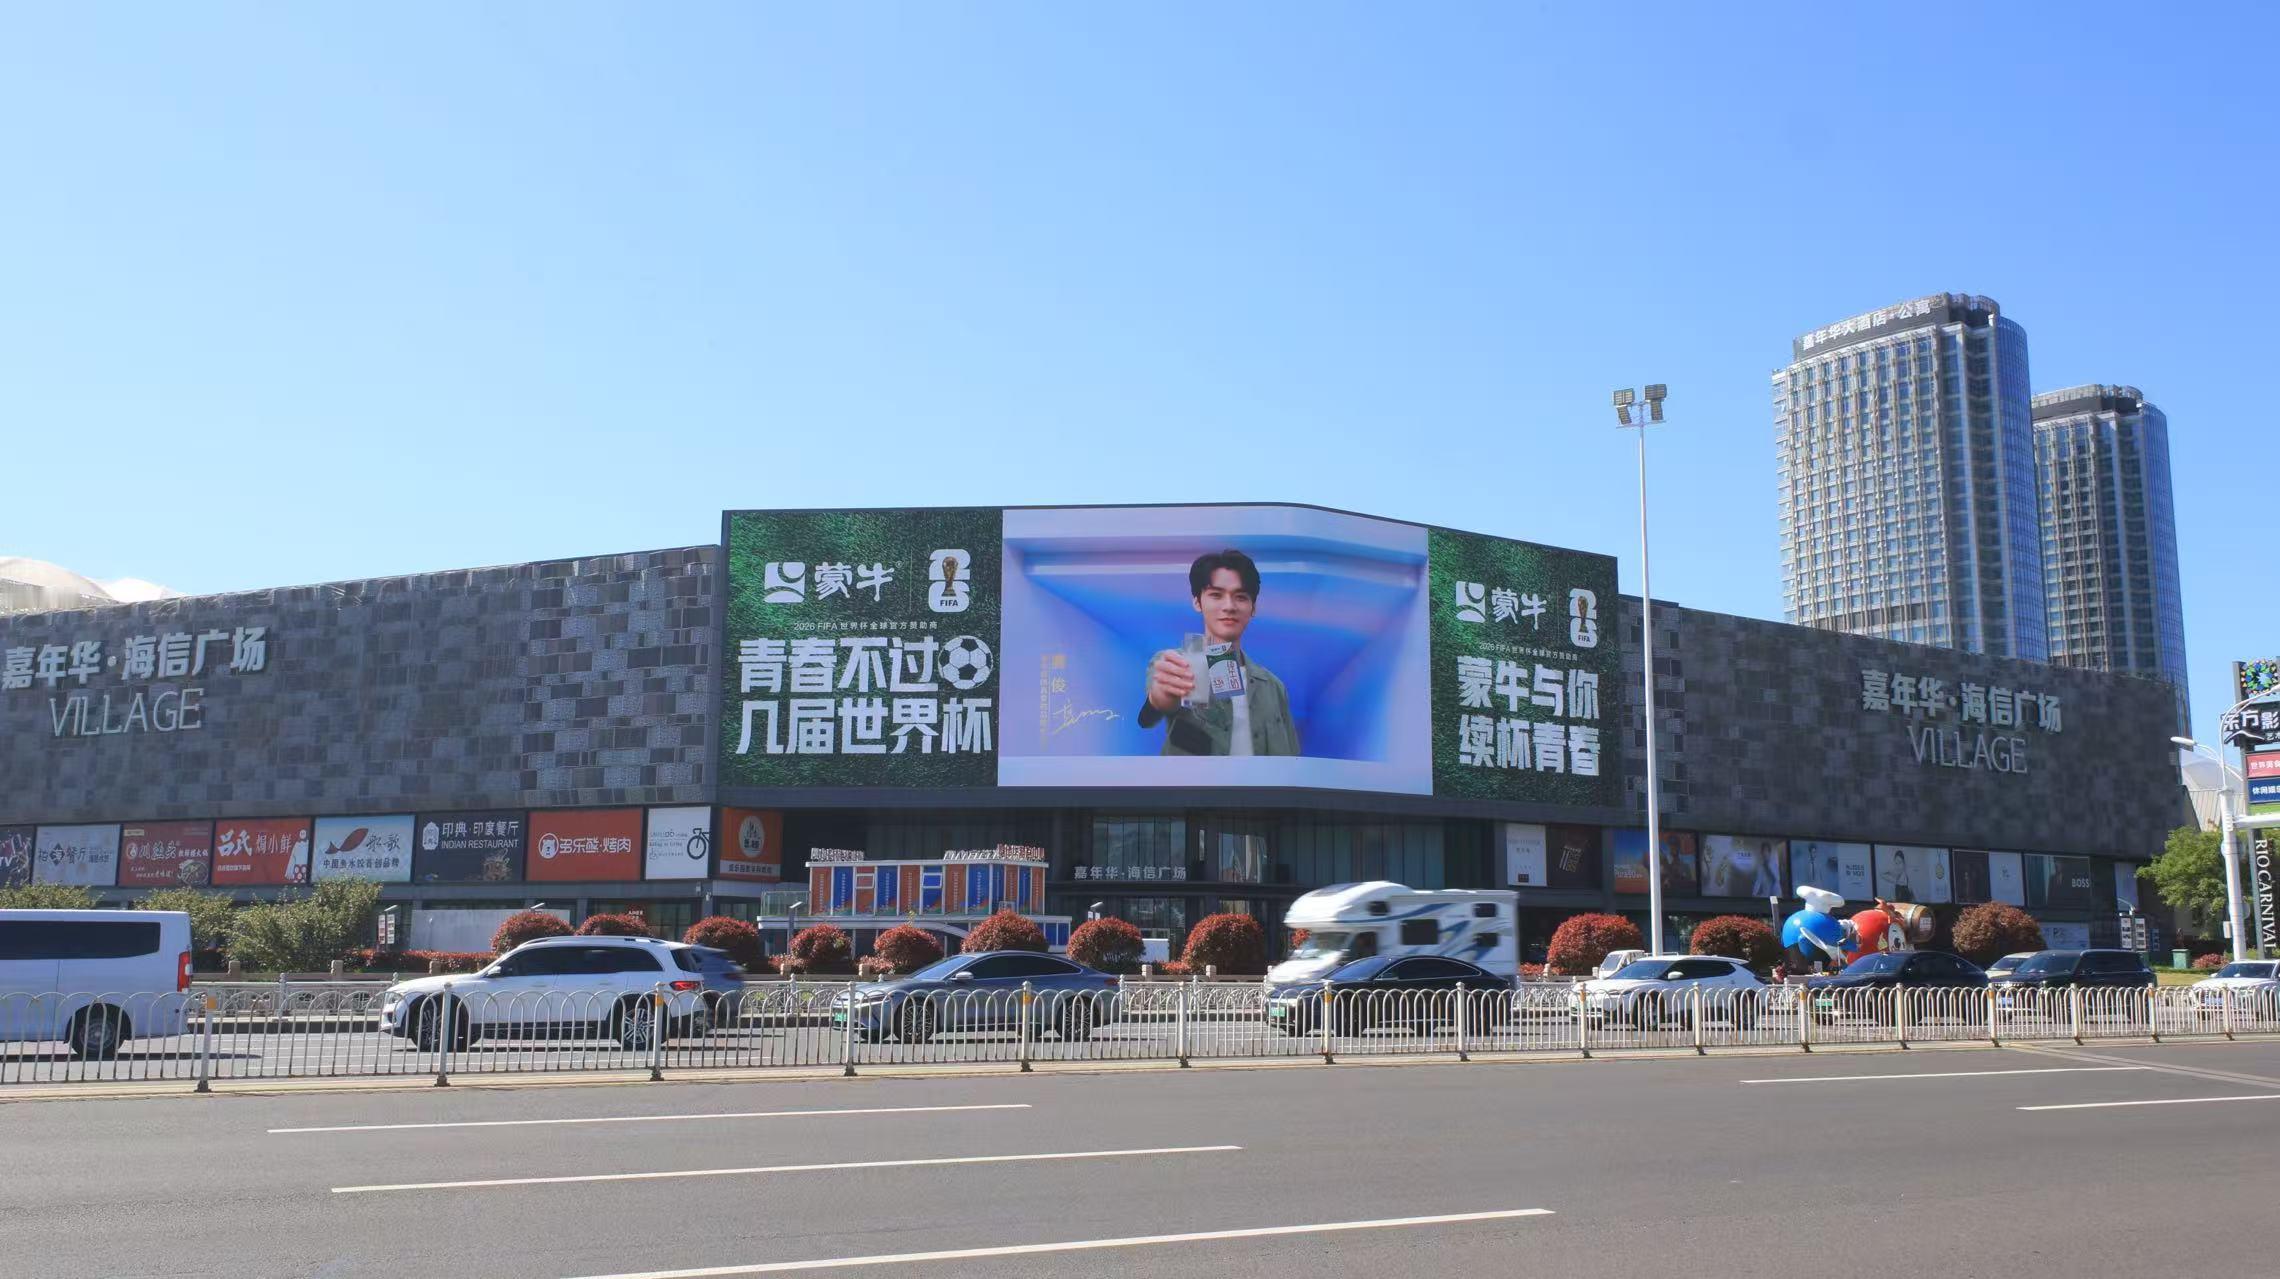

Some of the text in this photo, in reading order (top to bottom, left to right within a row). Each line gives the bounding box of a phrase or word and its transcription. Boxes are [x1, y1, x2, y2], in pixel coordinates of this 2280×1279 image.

[815, 561, 895, 602] 蒙牛
[794, 621, 938, 631] 2026 FIFA 世界杯全球官方赞助商
[1491, 586, 1547, 630] 蒙牛
[1, 626, 267, 689] 嘉年华·海信广场
[1577, 634, 1591, 643] FIFA
[738, 636, 939, 692] 青春不过
[1457, 656, 1600, 719] 蒙牛与你
[50, 687, 205, 737] VILLAGE
[1862, 669, 2062, 733] 嘉年华·海信广场
[735, 697, 992, 754] 几届世界杯
[1459, 714, 1600, 776] 续杯青春
[1907, 726, 2028, 774] VILLAGE
[441, 838, 519, 849] INDIAN RESTAURANT
[1073, 865, 1187, 881] 嘉年华·海信广场
[2071, 878, 2090, 888] BOSS
